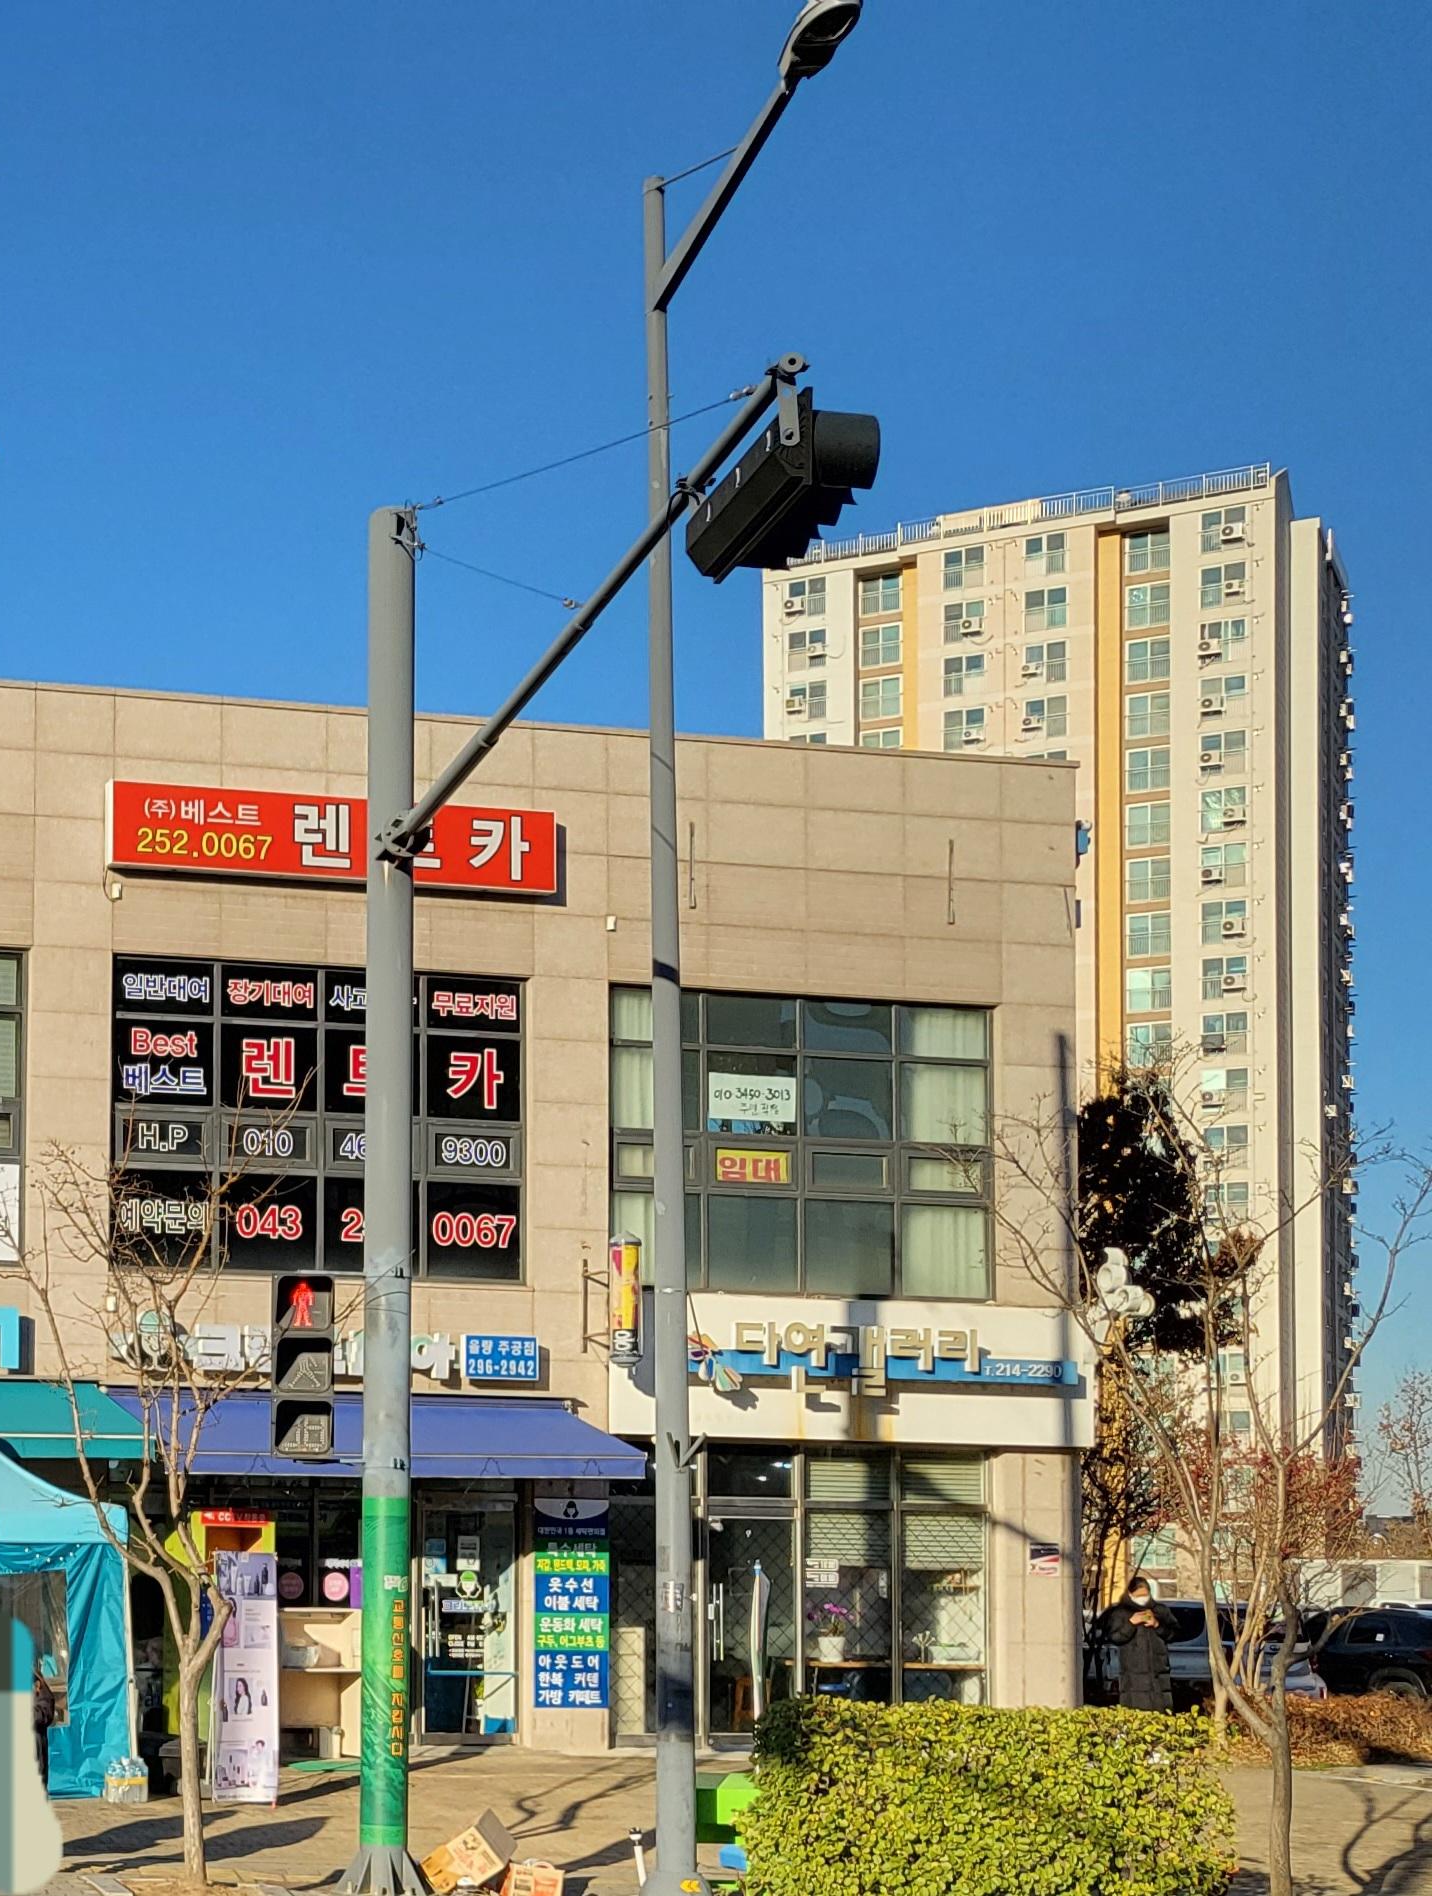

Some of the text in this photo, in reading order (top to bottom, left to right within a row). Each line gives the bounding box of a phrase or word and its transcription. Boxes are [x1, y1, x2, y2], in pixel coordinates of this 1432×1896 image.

[136, 827, 273, 861] 252.0067
[122, 973, 210, 1003] 일반대여
[227, 978, 315, 1008] 장기대여
[431, 990, 517, 1021] 무료지원
[130, 1026, 198, 1059] Best
[123, 1063, 207, 1096] 베스트
[138, 1122, 189, 1153] H.P
[242, 1128, 294, 1158] 010
[441, 1136, 507, 1168] 9300
[718, 1156, 782, 1183] 임대
[235, 1203, 303, 1241] 043
[431, 1210, 517, 1249] 0067
[497, 1340, 535, 1357] 주공점
[469, 1359, 535, 1377] 296-2942
[984, 1362, 1063, 1379] T.214-2290
[544, 1595, 599, 1611] 이불 세탁
[539, 1616, 604, 1633] 운동화 세탁
[537, 1671, 564, 1688] 한복
[537, 1689, 564, 1705] 가방
